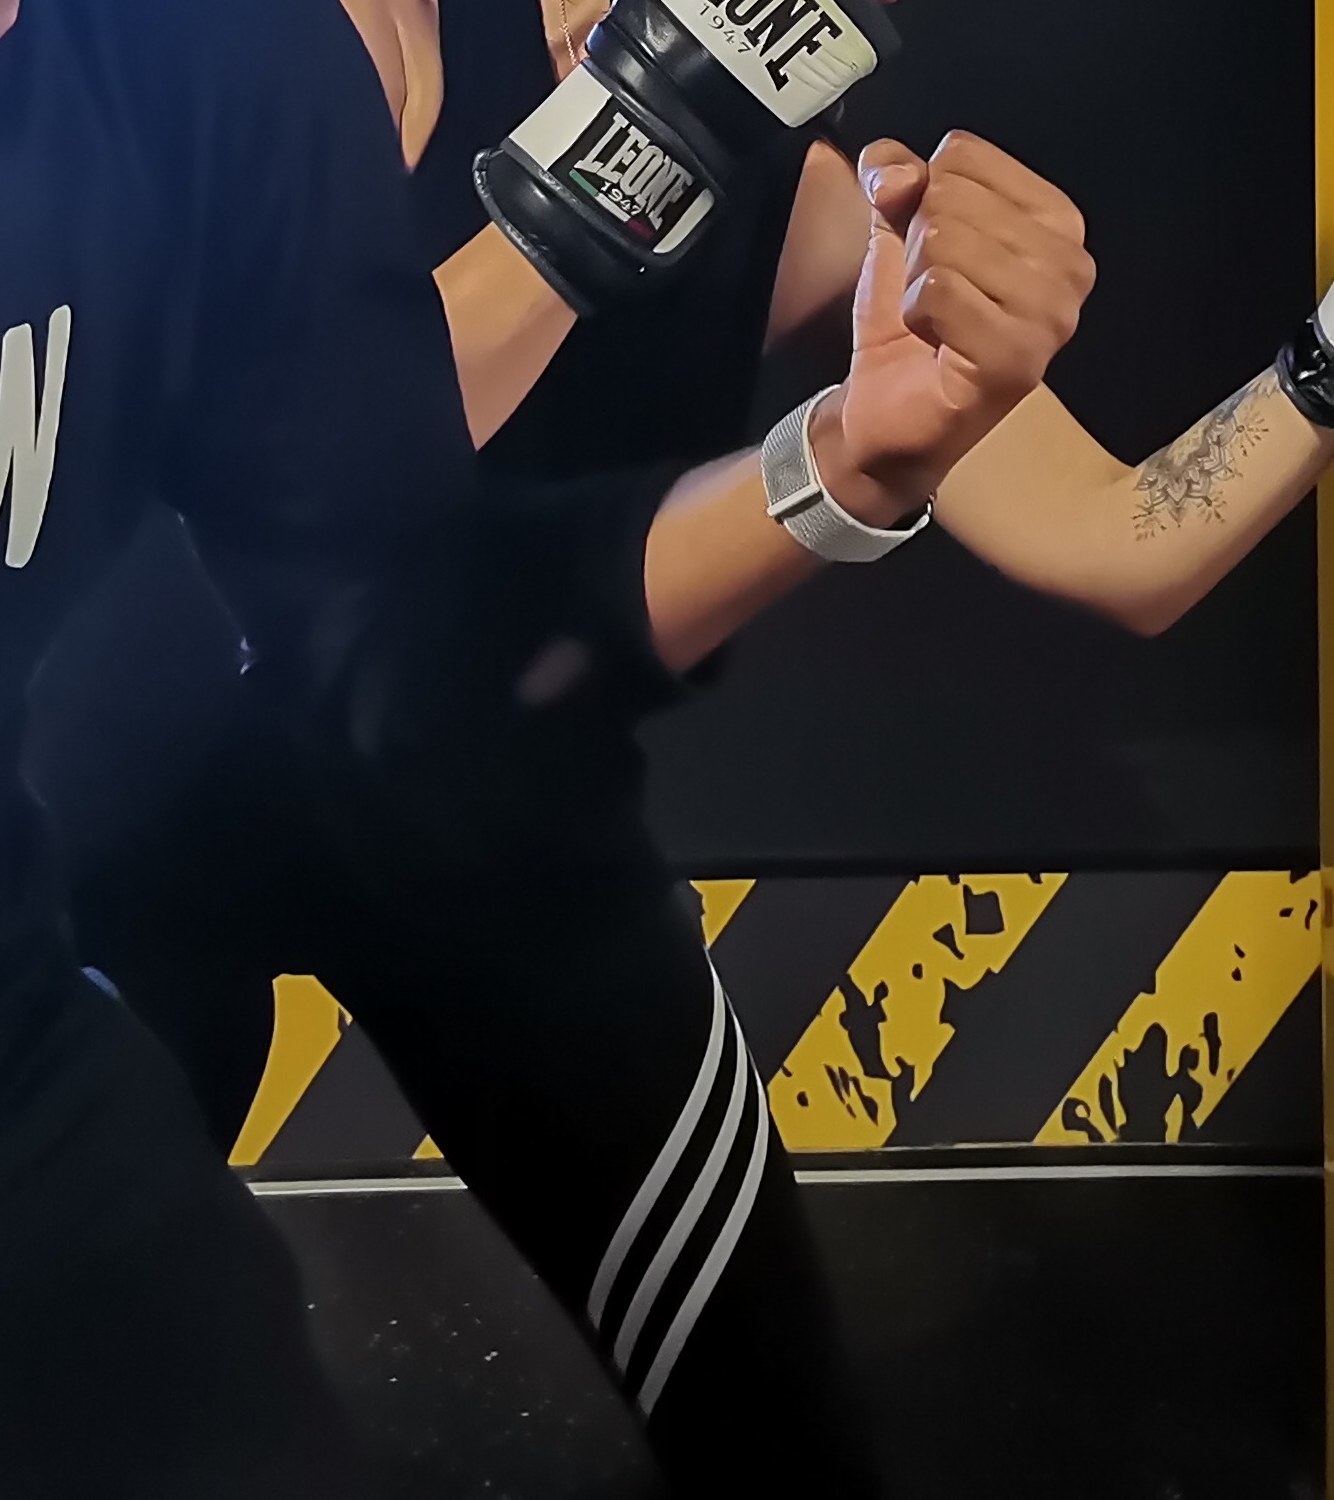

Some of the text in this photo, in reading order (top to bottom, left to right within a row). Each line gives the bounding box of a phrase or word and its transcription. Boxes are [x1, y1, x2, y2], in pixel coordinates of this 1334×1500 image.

[699, 2, 752, 55] 1947
[573, 111, 695, 231] LEONE
[599, 179, 643, 217] 1947
